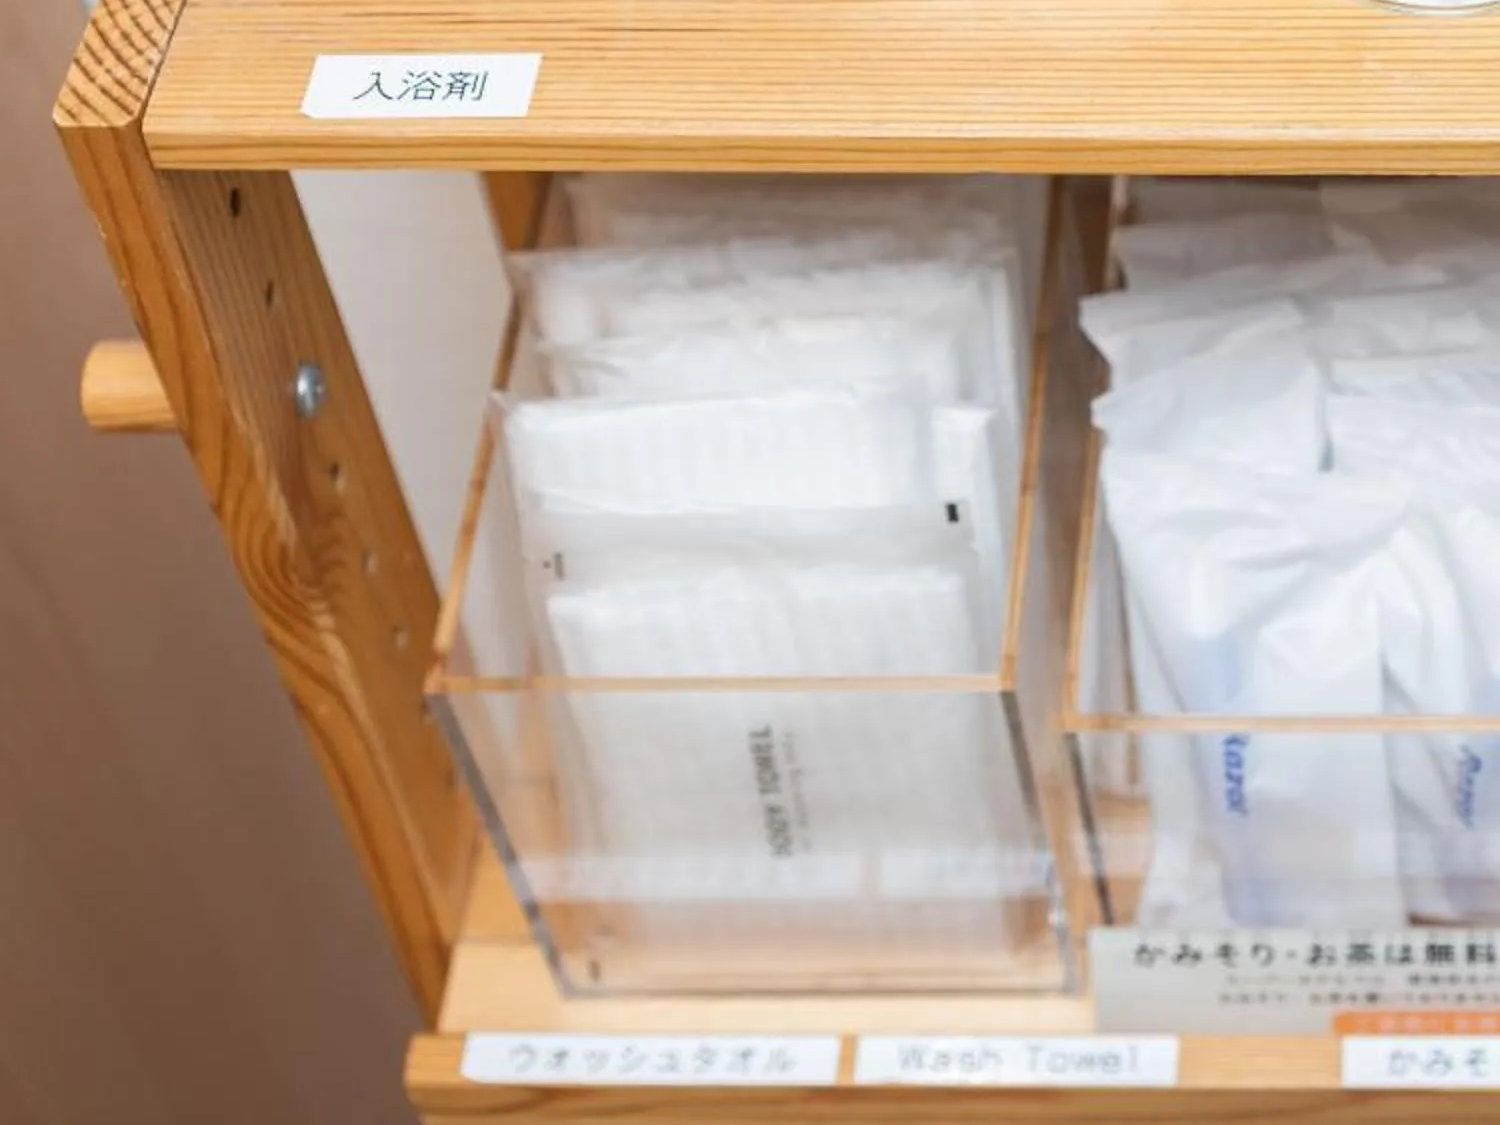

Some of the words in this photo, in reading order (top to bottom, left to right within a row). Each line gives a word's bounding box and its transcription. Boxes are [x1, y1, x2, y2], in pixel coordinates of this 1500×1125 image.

[352, 70, 489, 102] 入浴剤
[508, 1042, 798, 1075] ウォッシュタオル
[899, 1044, 1004, 1073] Wash
[1026, 1044, 1140, 1074] Towel
